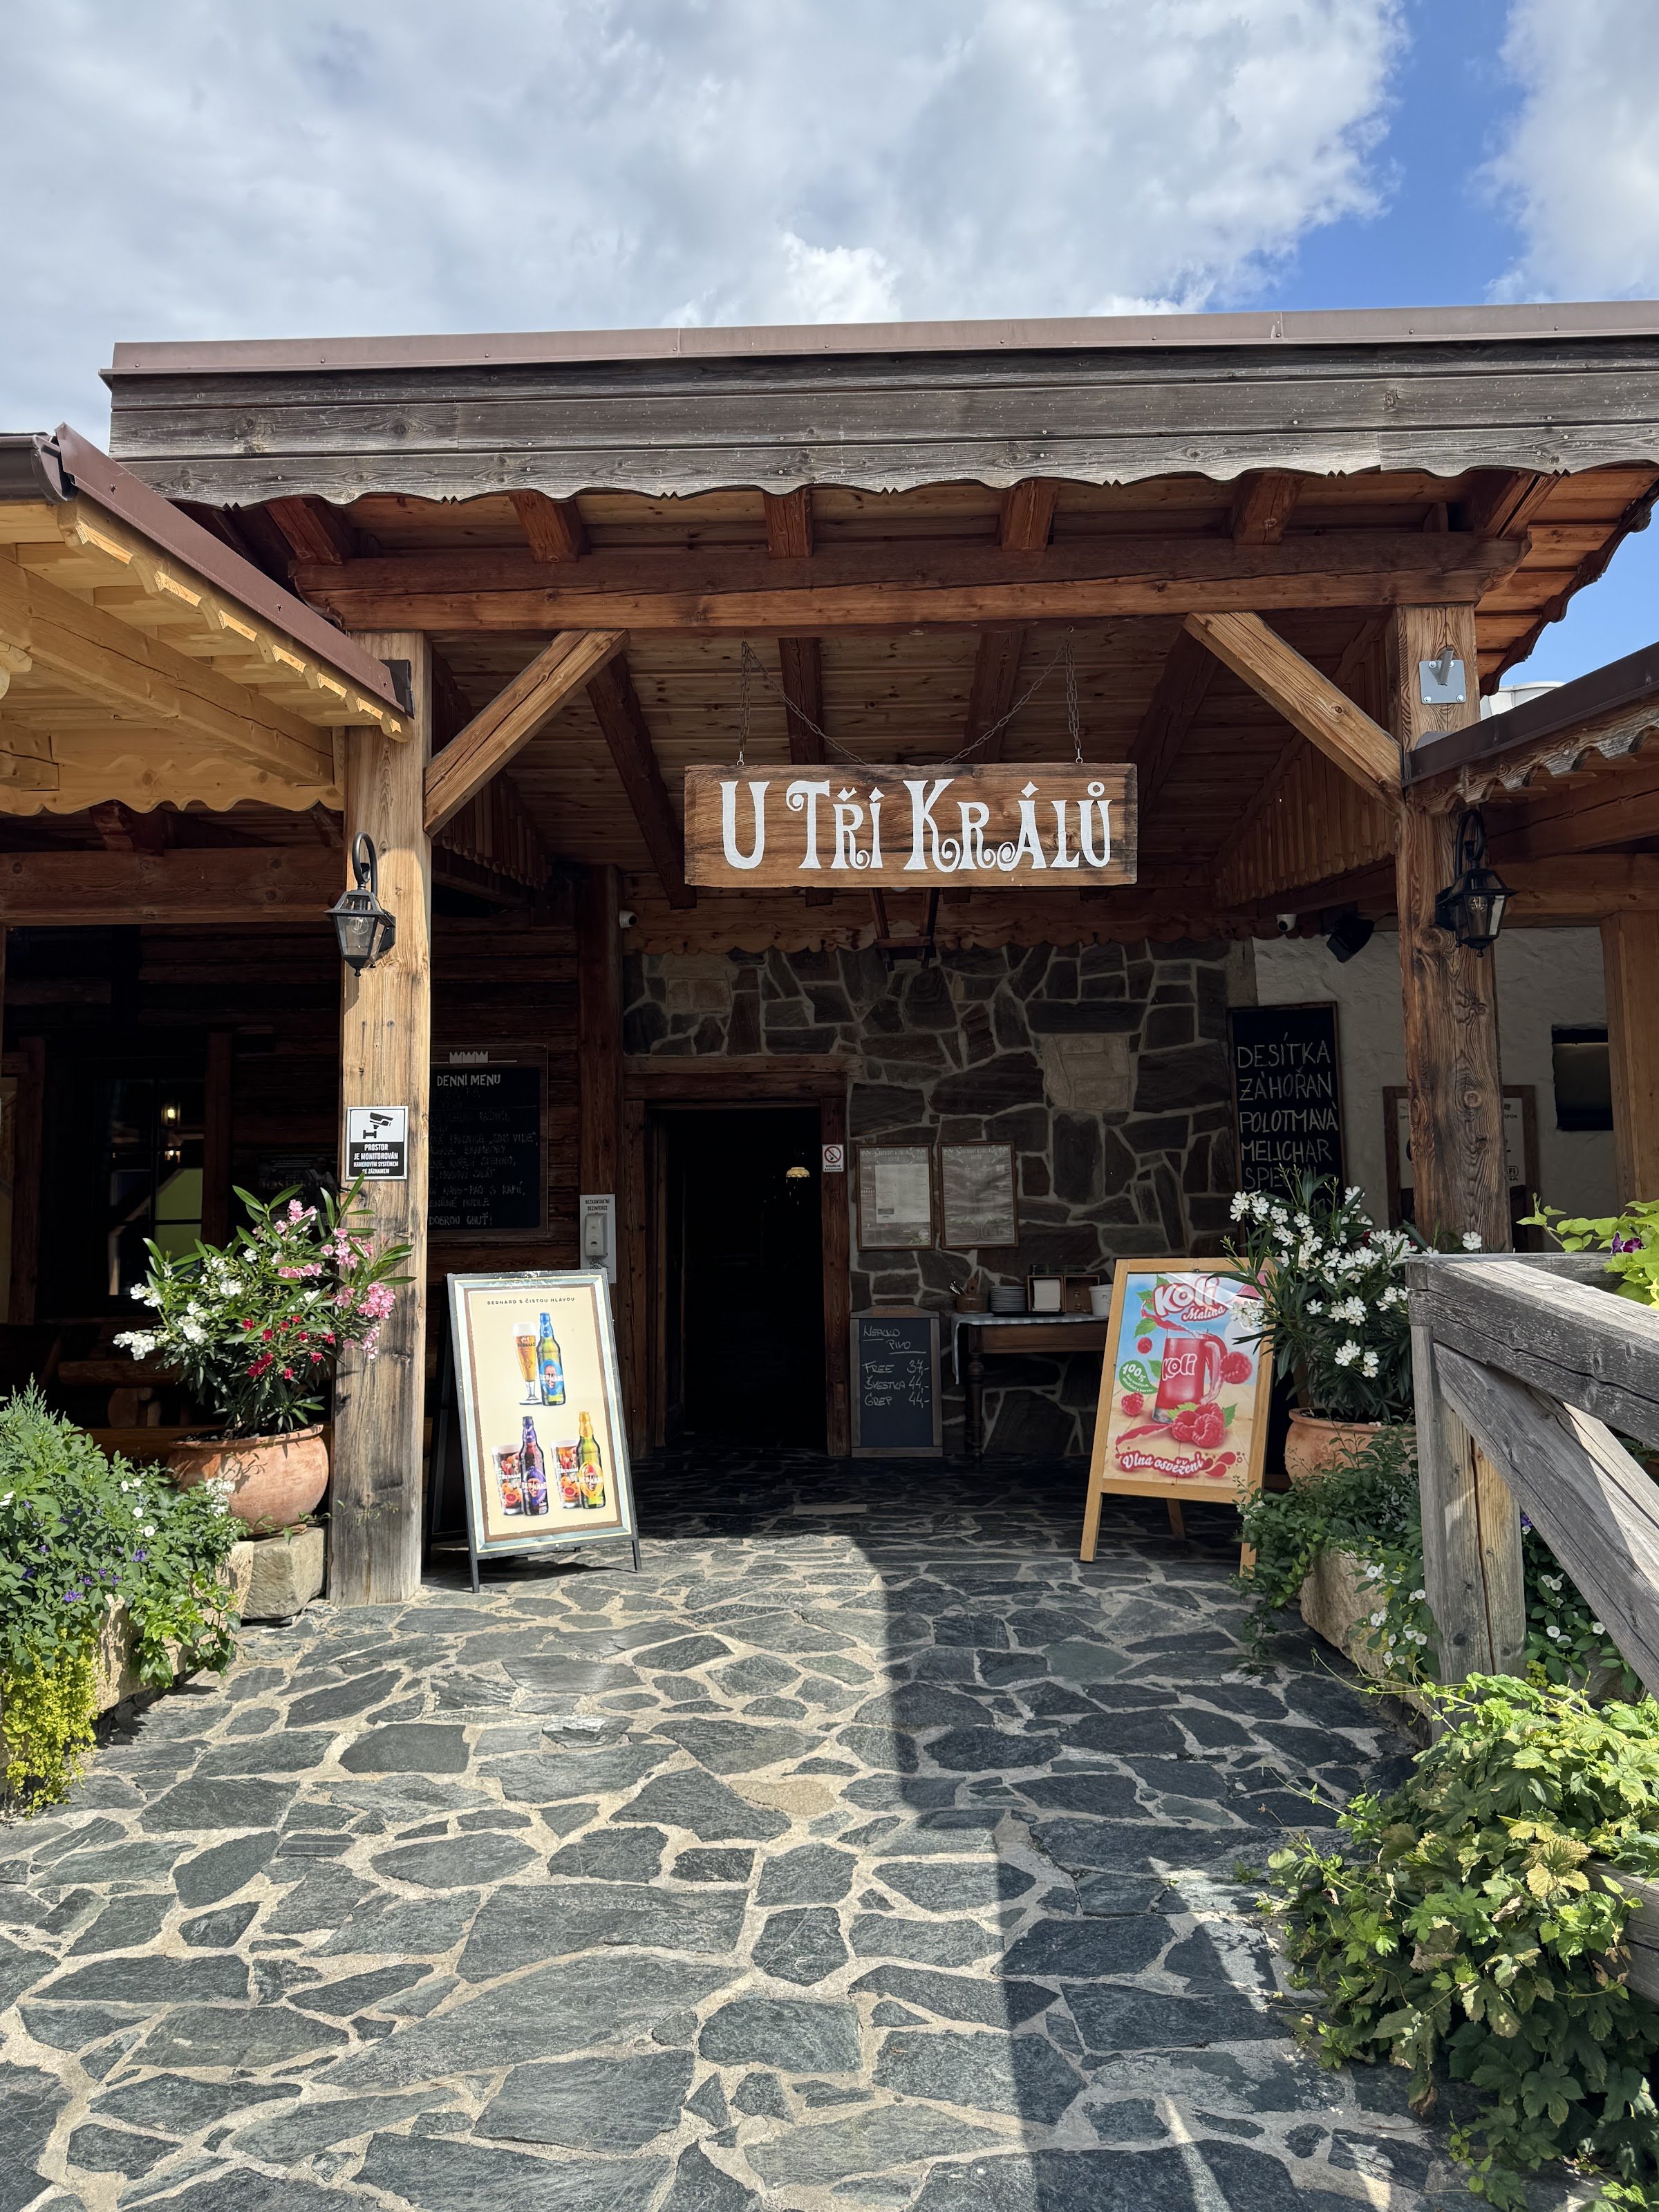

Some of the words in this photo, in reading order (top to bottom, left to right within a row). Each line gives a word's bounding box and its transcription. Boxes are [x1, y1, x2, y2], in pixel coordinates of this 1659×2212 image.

[719, 780, 770, 869] U
[786, 779, 885, 870] TŘÍ
[903, 778, 1113, 873] KRÁLŮ
[1237, 1032, 1331, 1068] DESÍTKA
[437, 1073, 467, 1087] DENNÍ
[471, 1074, 501, 1086] MENU
[1239, 1065, 1332, 1100] ZÁHOŘAN
[1239, 1102, 1338, 1133] POLOTMAVÁ
[361, 1152, 398, 1160] MONITOROVÁN
[1241, 1138, 1333, 1163] MELICHAR
[429, 1215, 460, 1226] DOBROU
[885, 1339, 911, 1350] PIVO
[862, 1360, 894, 1373] FREE
[1123, 1364, 1146, 1382] 100%
[864, 1375, 905, 1390] ŠVESTKA
[865, 1392, 892, 1406] GREP
[1123, 1453, 1153, 1468] Vlna
